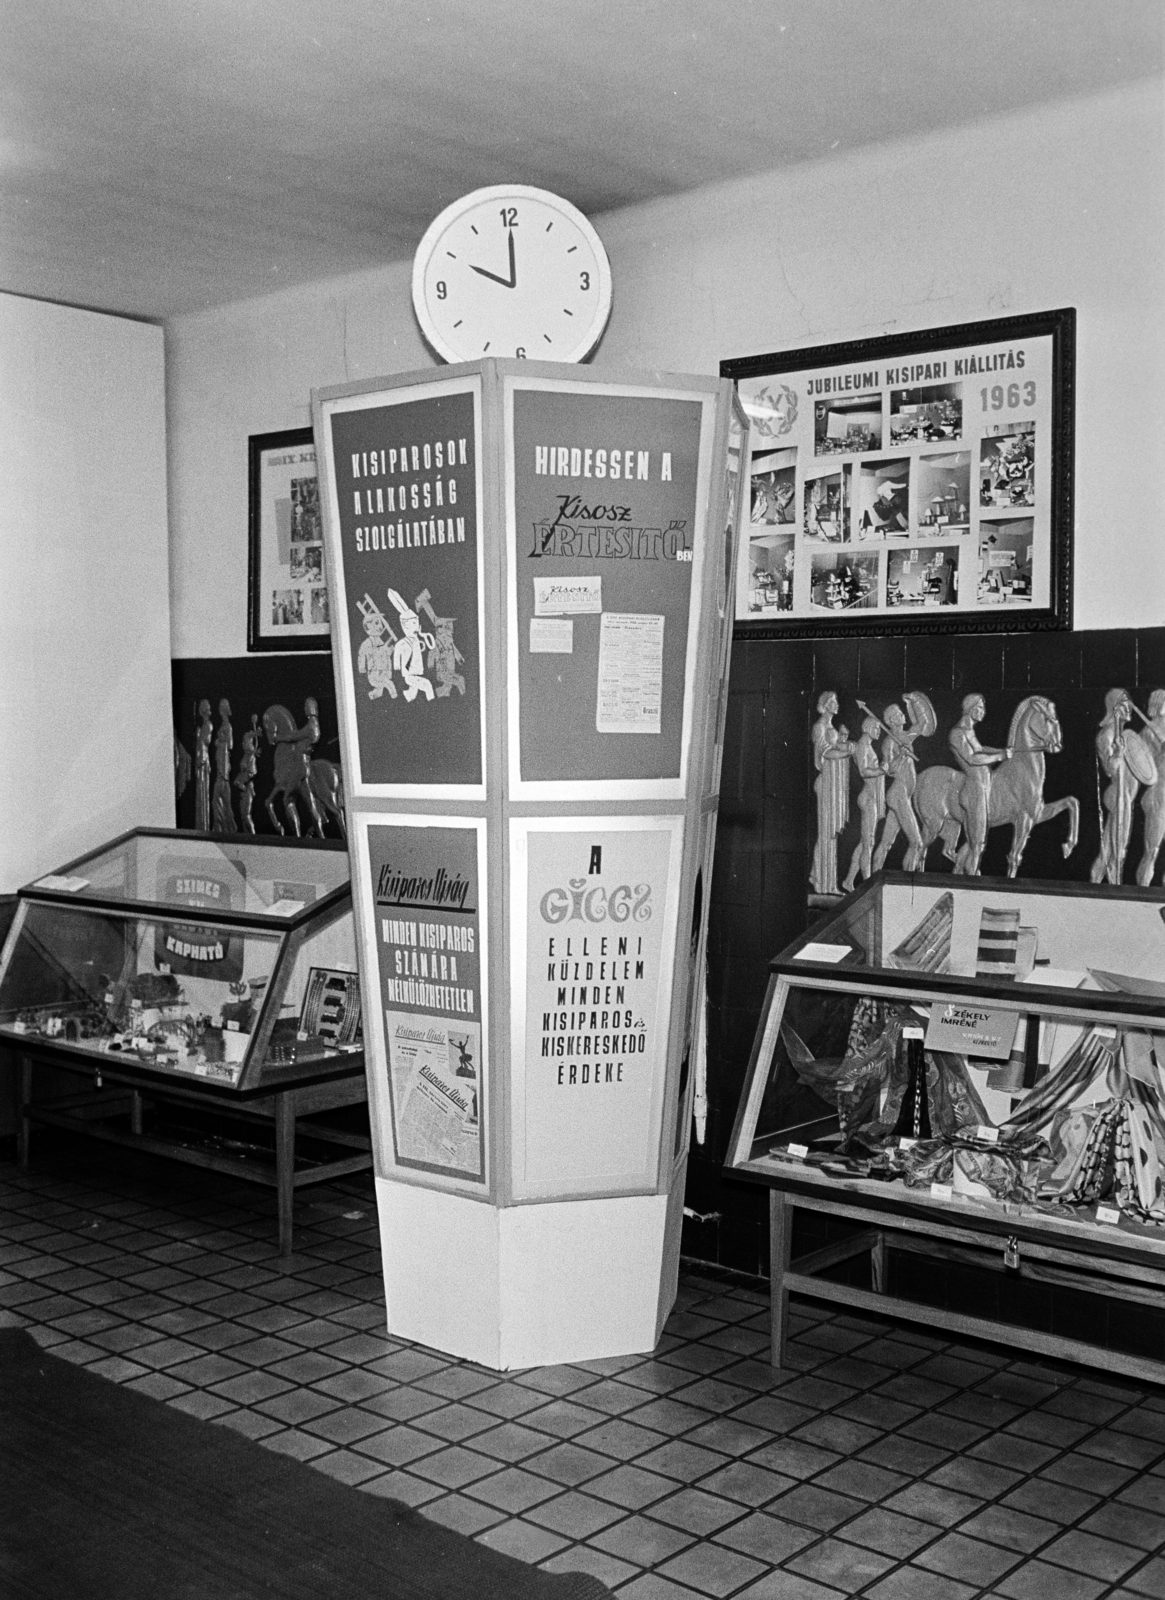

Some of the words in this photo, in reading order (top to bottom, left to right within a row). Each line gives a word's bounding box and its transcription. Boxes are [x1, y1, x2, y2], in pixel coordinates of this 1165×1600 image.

[500, 207, 519, 228] 12
[436, 281, 448, 300] 9
[579, 271, 591, 291] 3
[807, 371, 879, 395] JUBILEUMI
[886, 361, 947, 385] KISIPARI
[979, 380, 1037, 412] 1963
[352, 438, 467, 479] KISIPAROSOK
[535, 446, 649, 480] HIRDESSEN
[661, 452, 672, 481] A
[356, 515, 465, 552] SZOLGÁLATÁBAN
[677, 550, 693, 561] BEN
[588, 845, 602, 874] A
[376, 864, 433, 902] Kisiparos
[382, 919, 417, 946] MINDEN
[419, 922, 475, 953] KISIPAROS
[549, 936, 642, 957] ELLENI
[395, 948, 457, 981] SZÁMÁRA
[548, 960, 644, 981] KÜZDELEM
[388, 977, 474, 1013] NÉLKÜLÖZHETETLEN
[557, 986, 625, 1006] MINDEN
[543, 1010, 632, 1031] KISIPAROS
[941, 1017, 978, 1029] IMRÉNÉ
[944, 1003, 991, 1021] SZÉKELY
[541, 1029, 647, 1057] KISKERESKEDŐ
[558, 1061, 624, 1085] ÉRDEKE
